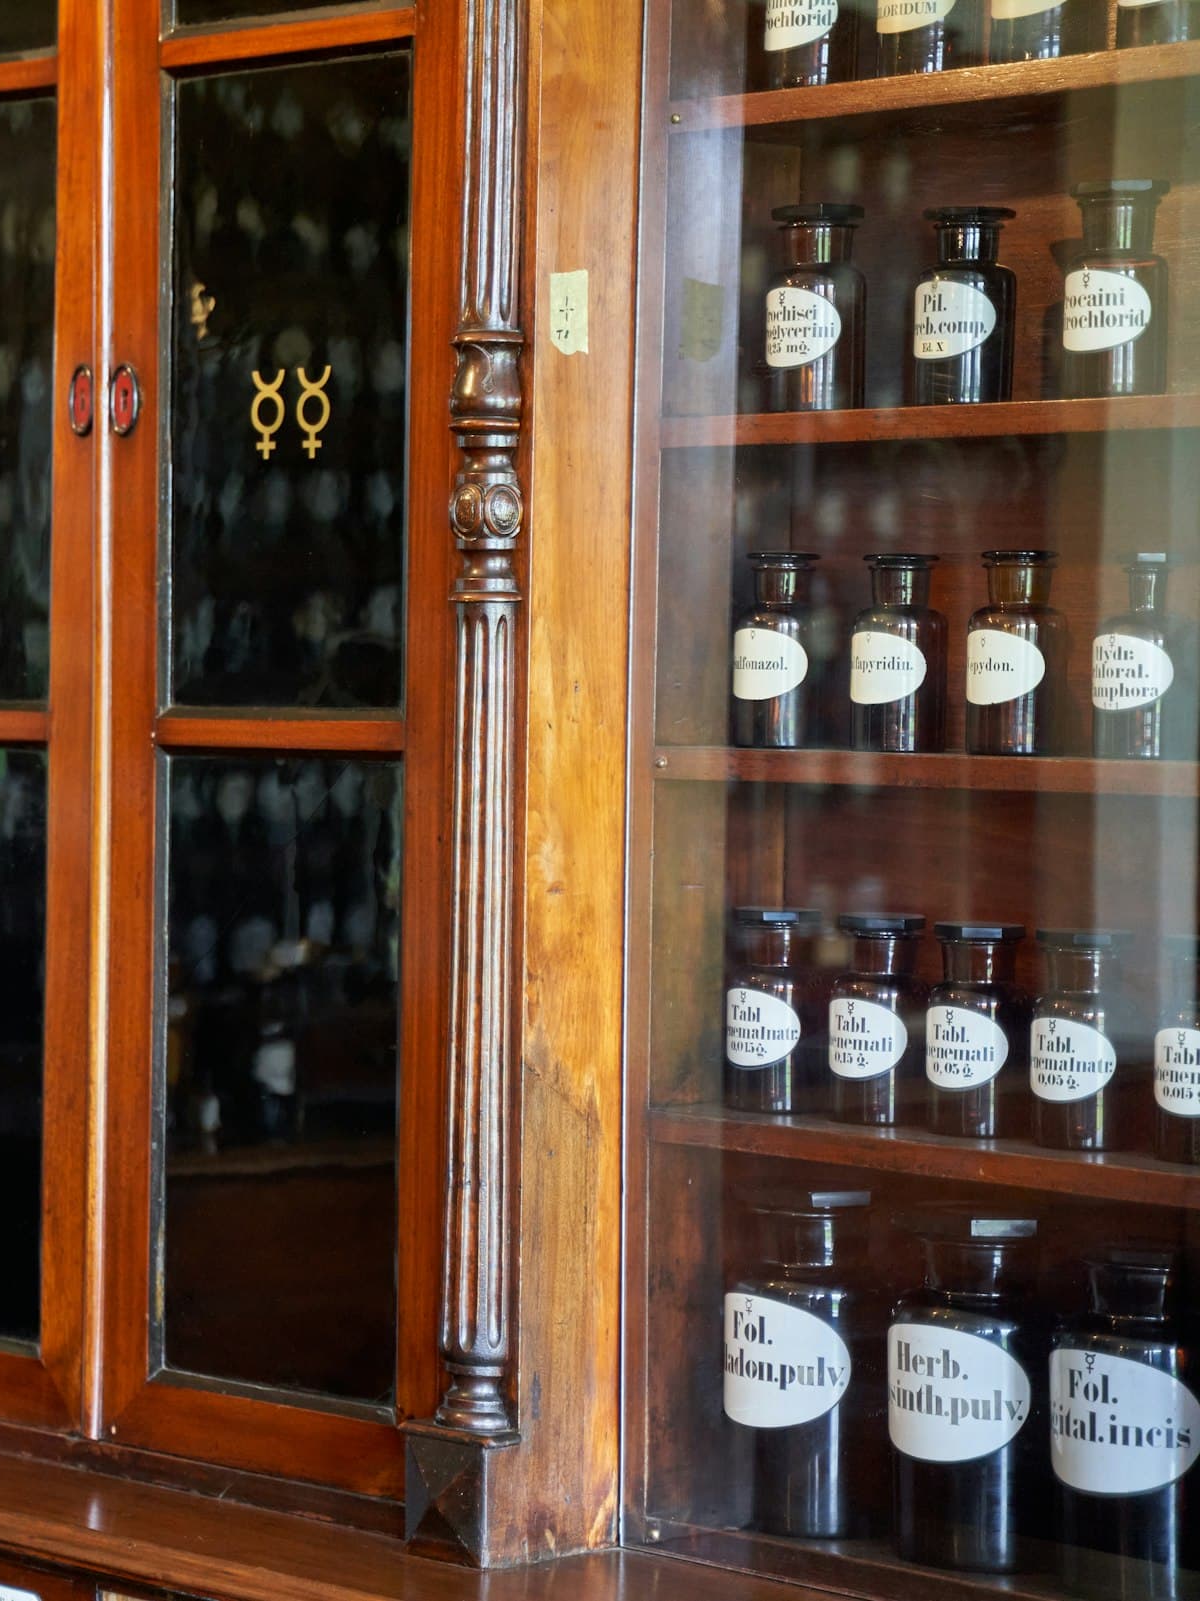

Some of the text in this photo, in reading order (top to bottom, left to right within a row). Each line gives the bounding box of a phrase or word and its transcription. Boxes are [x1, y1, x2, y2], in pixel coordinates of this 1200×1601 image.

[923, 293, 947, 312] Pil.
[835, 1014, 870, 1033] Tabl.
[933, 1024, 970, 1043] Tabl.
[1037, 1033, 1075, 1053] Tabl.
[733, 1310, 773, 1345] Fol.
[897, 1340, 968, 1380] Herb.
[1069, 1368, 1118, 1404] Fol.
